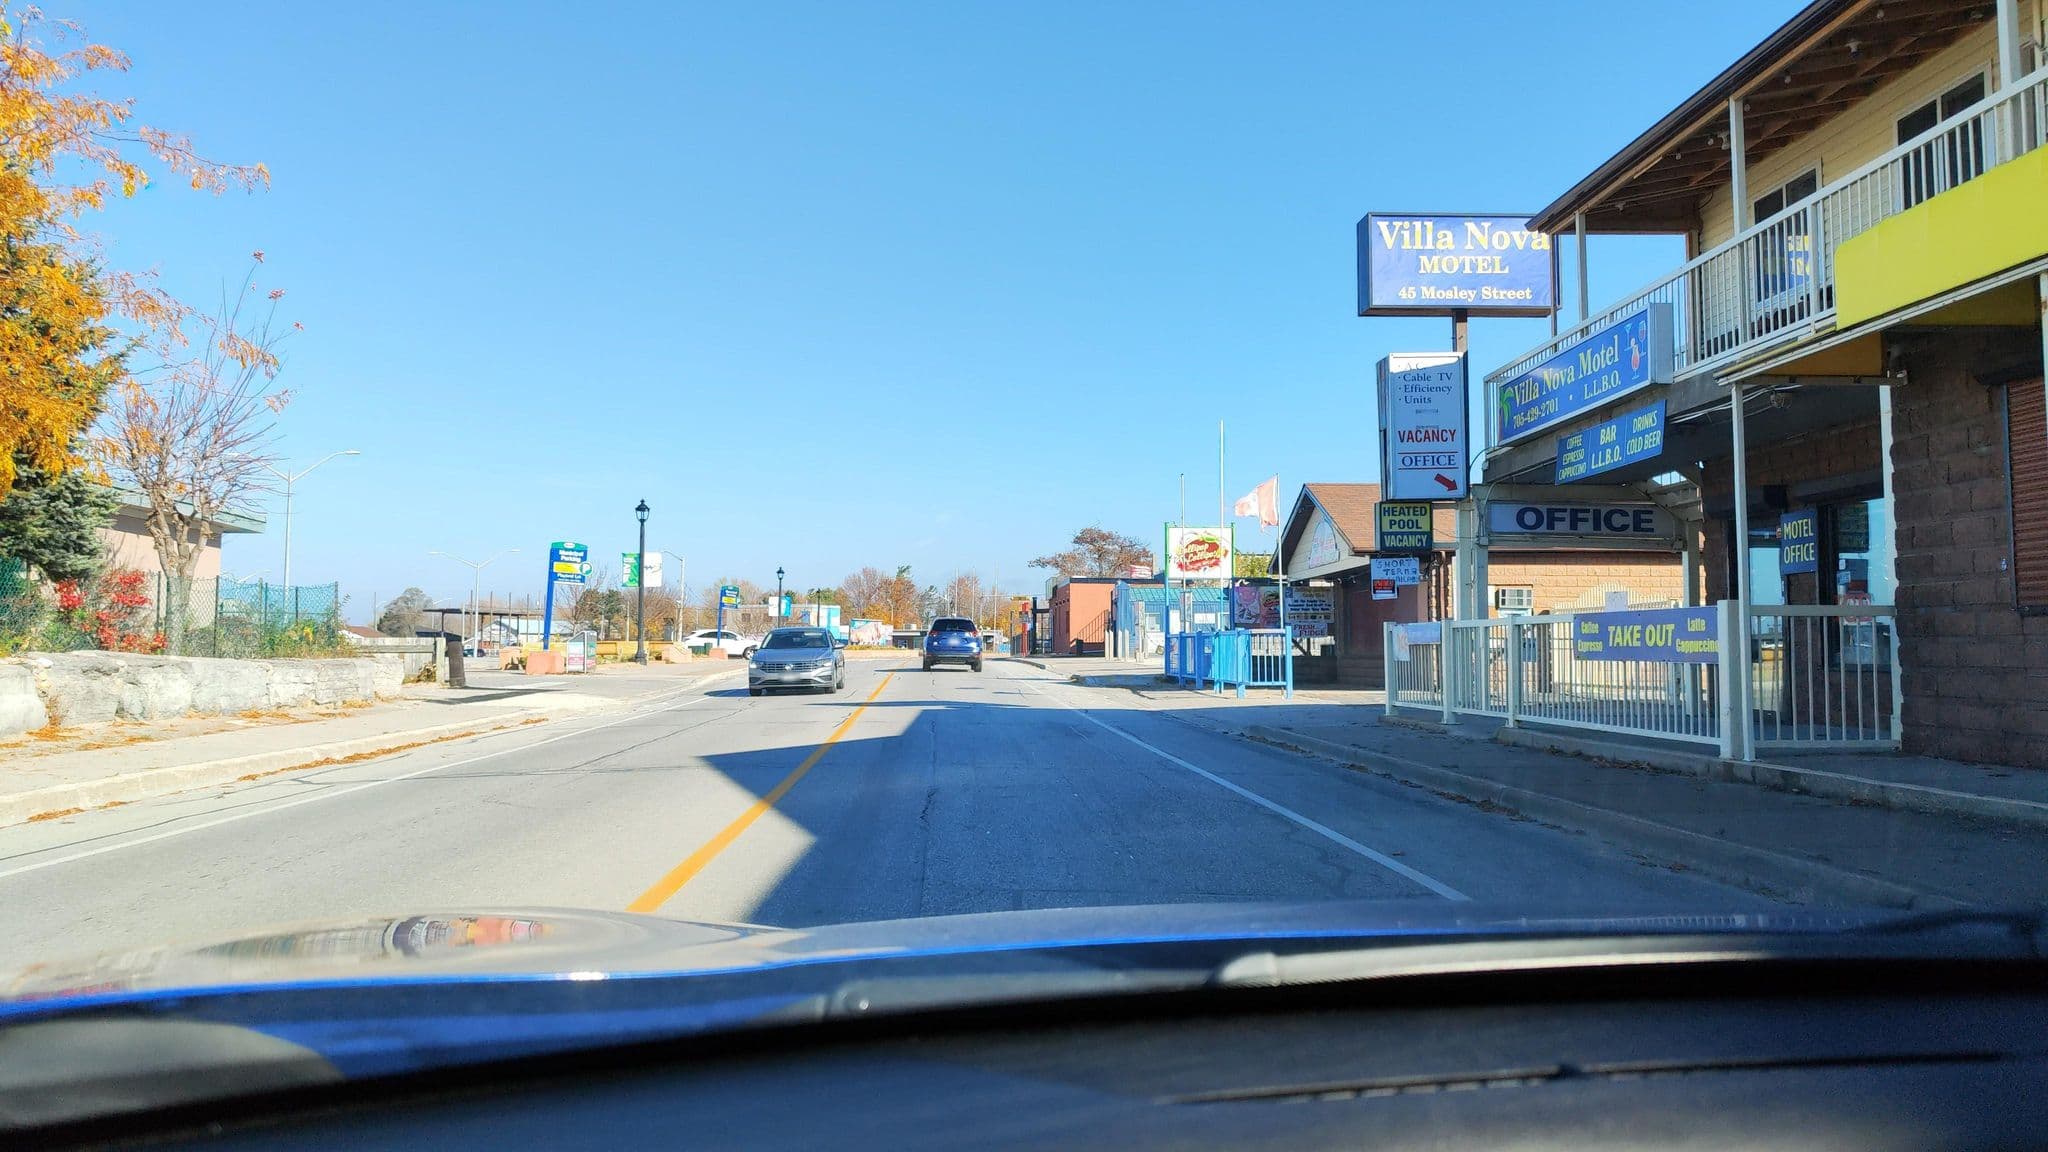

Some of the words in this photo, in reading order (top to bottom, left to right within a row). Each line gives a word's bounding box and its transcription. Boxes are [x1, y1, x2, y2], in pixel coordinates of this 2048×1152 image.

[1377, 221, 1455, 250] Villa
[1464, 222, 1551, 250] Nova
[1418, 255, 1509, 274] MOTEL
[1398, 286, 1417, 300] 45
[1420, 286, 1477, 302] Mosley
[1481, 286, 1532, 300] Street
[1402, 373, 1432, 382] Cable
[1438, 372, 1453, 381] TV
[1514, 378, 1539, 408] Villa
[1542, 365, 1575, 396] Nova
[1579, 335, 1619, 378] Motel
[1404, 384, 1453, 395] Efficiency
[1583, 371, 1622, 400] L.L.B.O.
[1404, 396, 1432, 404] Units
[1632, 410, 1658, 433] DRINKS
[1398, 429, 1457, 443] VACANCY
[1600, 424, 1617, 445] BAR
[1627, 436, 1643, 455] COLD
[1644, 430, 1661, 450] BEER
[1402, 455, 1457, 467] OFFICE
[1591, 445, 1622, 469] L.L.B.O.
[1383, 506, 1428, 517] HEATED
[1515, 506, 1655, 533] OFFICE
[1389, 519, 1423, 530] POOL
[1783, 518, 1814, 541] MOTEL
[1384, 534, 1428, 547] VACANCY
[1783, 542, 1815, 565] OFFICE
[1608, 625, 1642, 647] TAKE
[1645, 624, 1676, 647] OUT
